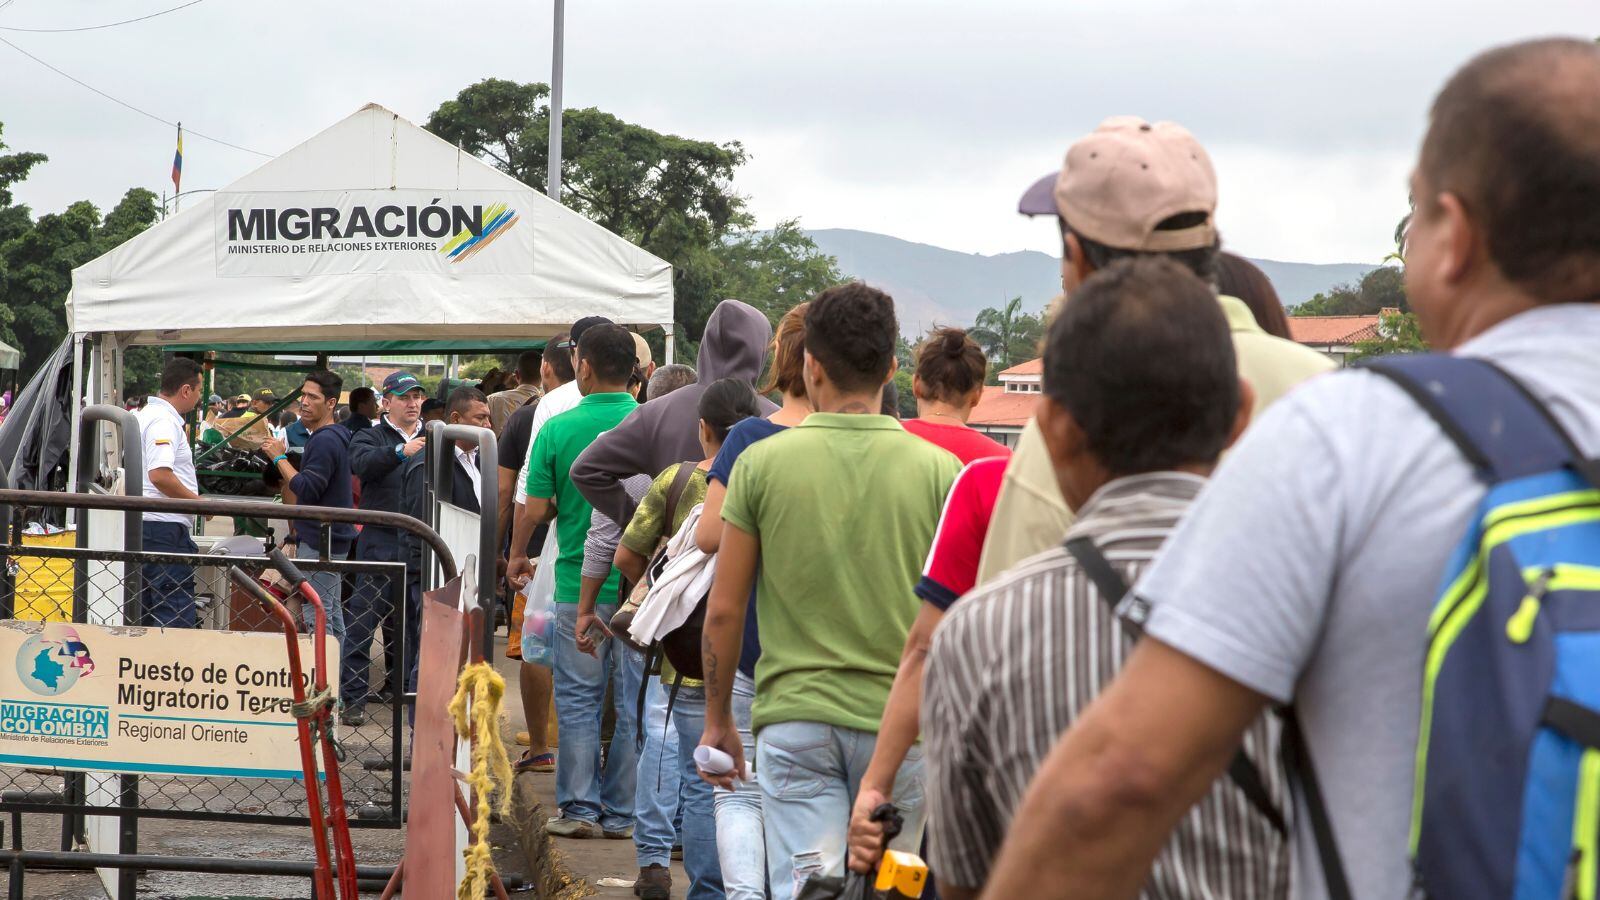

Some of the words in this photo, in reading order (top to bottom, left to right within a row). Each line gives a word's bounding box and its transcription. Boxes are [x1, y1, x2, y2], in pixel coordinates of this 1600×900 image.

[228, 198, 482, 241] MIGRACIÓN
[228, 244, 289, 254] MINISTERIO
[292, 244, 306, 254] DE
[308, 242, 372, 253] RELACIONES
[374, 241, 437, 252] EXTERIORES
[118, 657, 194, 684] Puesto
[201, 663, 227, 685] de
[117, 684, 229, 713] Migratorio
[236, 690, 291, 713] Terre
[0, 733, 29, 741] Ministerio
[41, 735, 75, 744] Relaciones
[77, 738, 108, 746] Exteriores
[1, 718, 106, 737] COLOMBIA
[118, 720, 186, 744] Regional
[192, 724, 248, 744] Oriente
